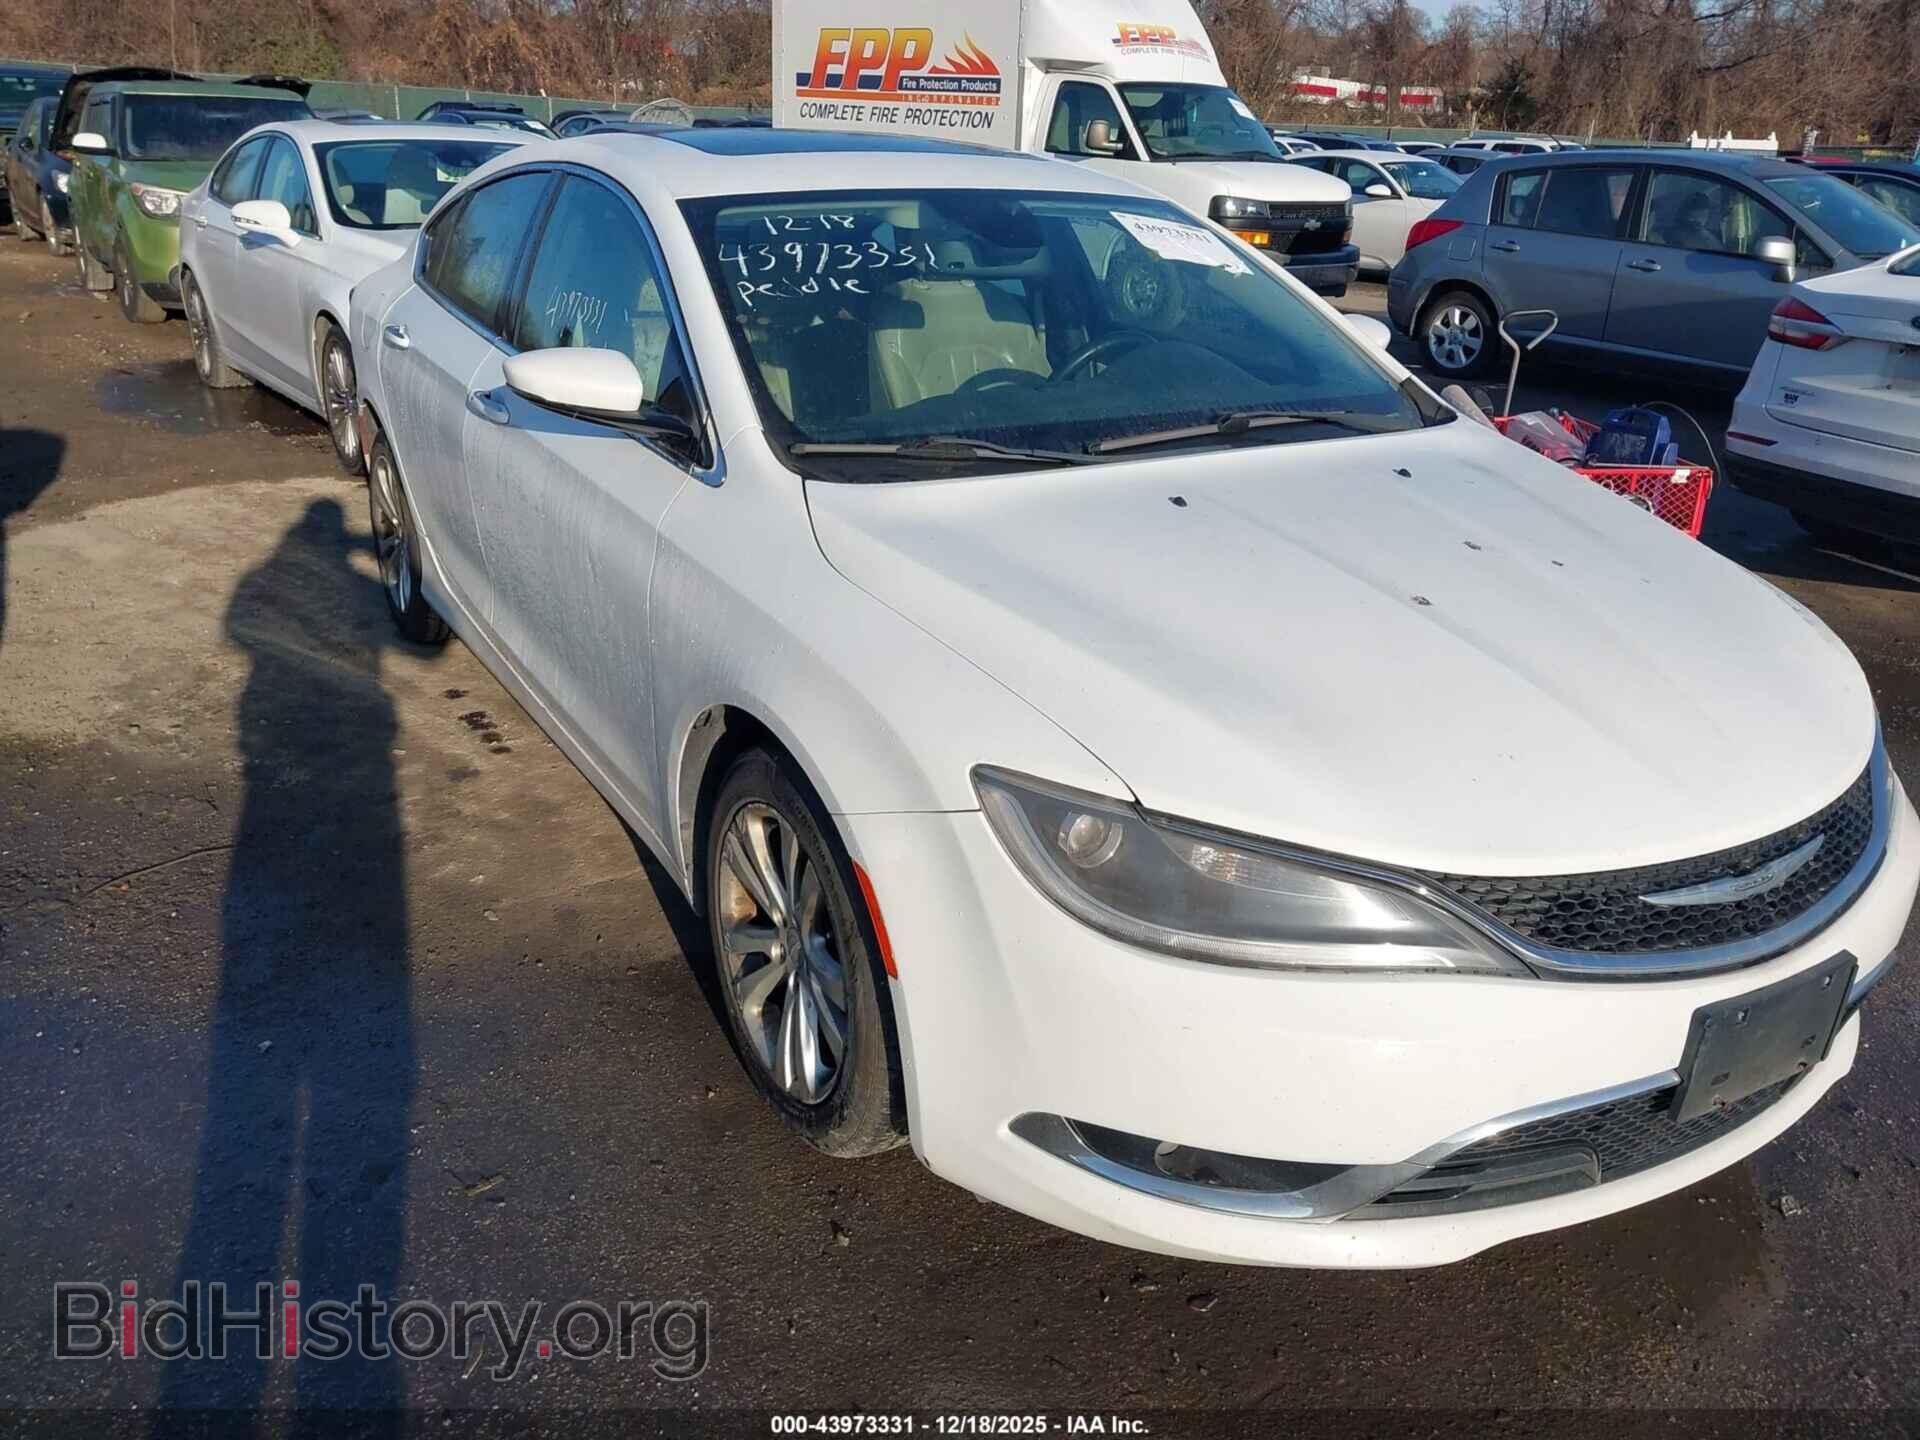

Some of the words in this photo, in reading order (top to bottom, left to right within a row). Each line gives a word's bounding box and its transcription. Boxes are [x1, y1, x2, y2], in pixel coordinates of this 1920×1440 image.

[808, 27, 934, 92] FPP
[902, 77, 917, 89] Fire
[919, 78, 959, 90] Protection
[961, 79, 997, 92] Products
[800, 102, 865, 121] COMPLETE
[869, 106, 900, 124] FIRE
[904, 107, 994, 129] PROTECTION
